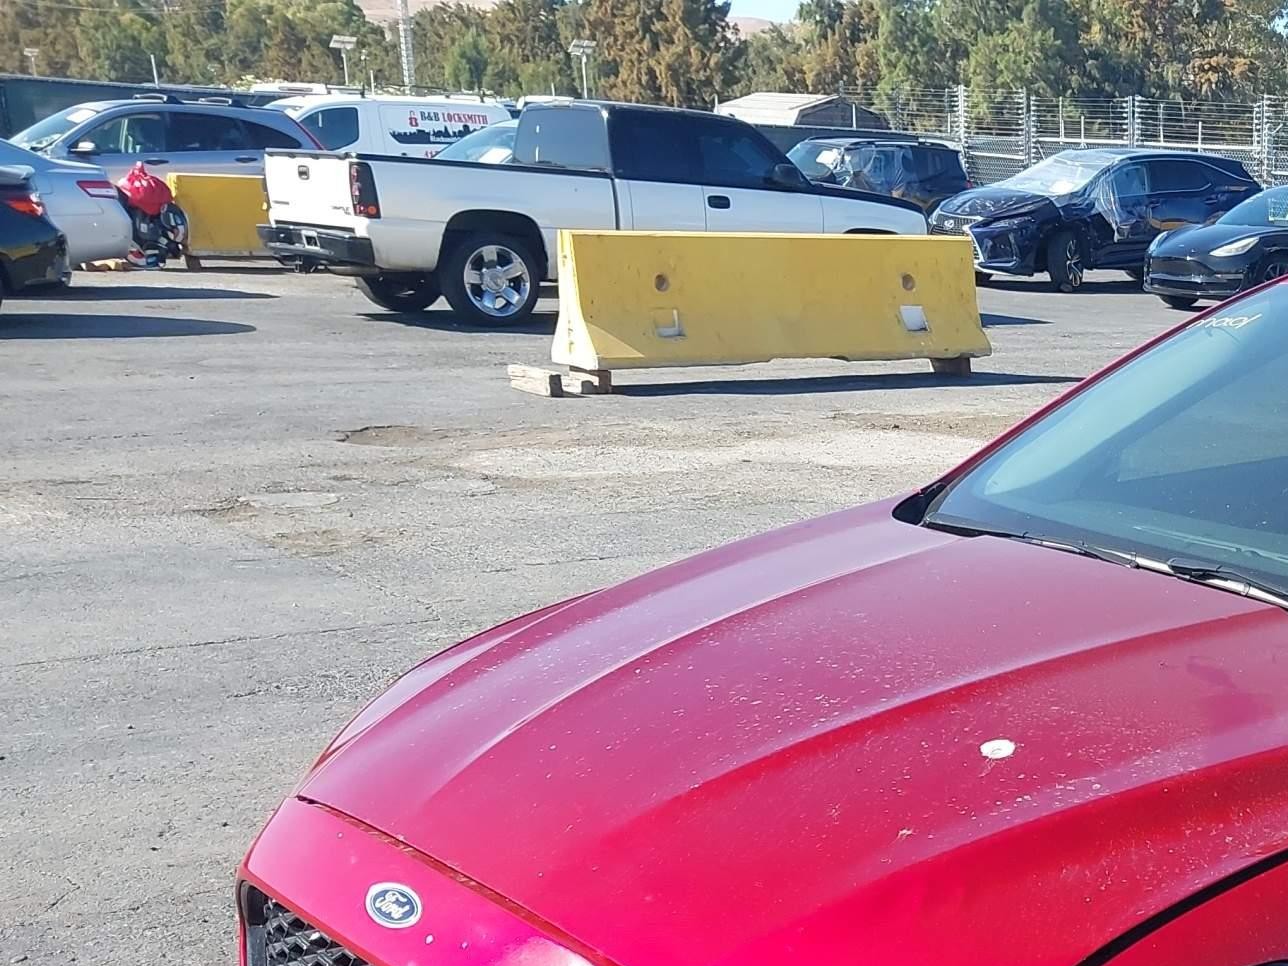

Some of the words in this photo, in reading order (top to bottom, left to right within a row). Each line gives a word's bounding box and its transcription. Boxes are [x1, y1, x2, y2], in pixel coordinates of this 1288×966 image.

[420, 111, 440, 122] B&B
[441, 112, 488, 125] LOCKSMITH
[375, 890, 410, 920] Ford
